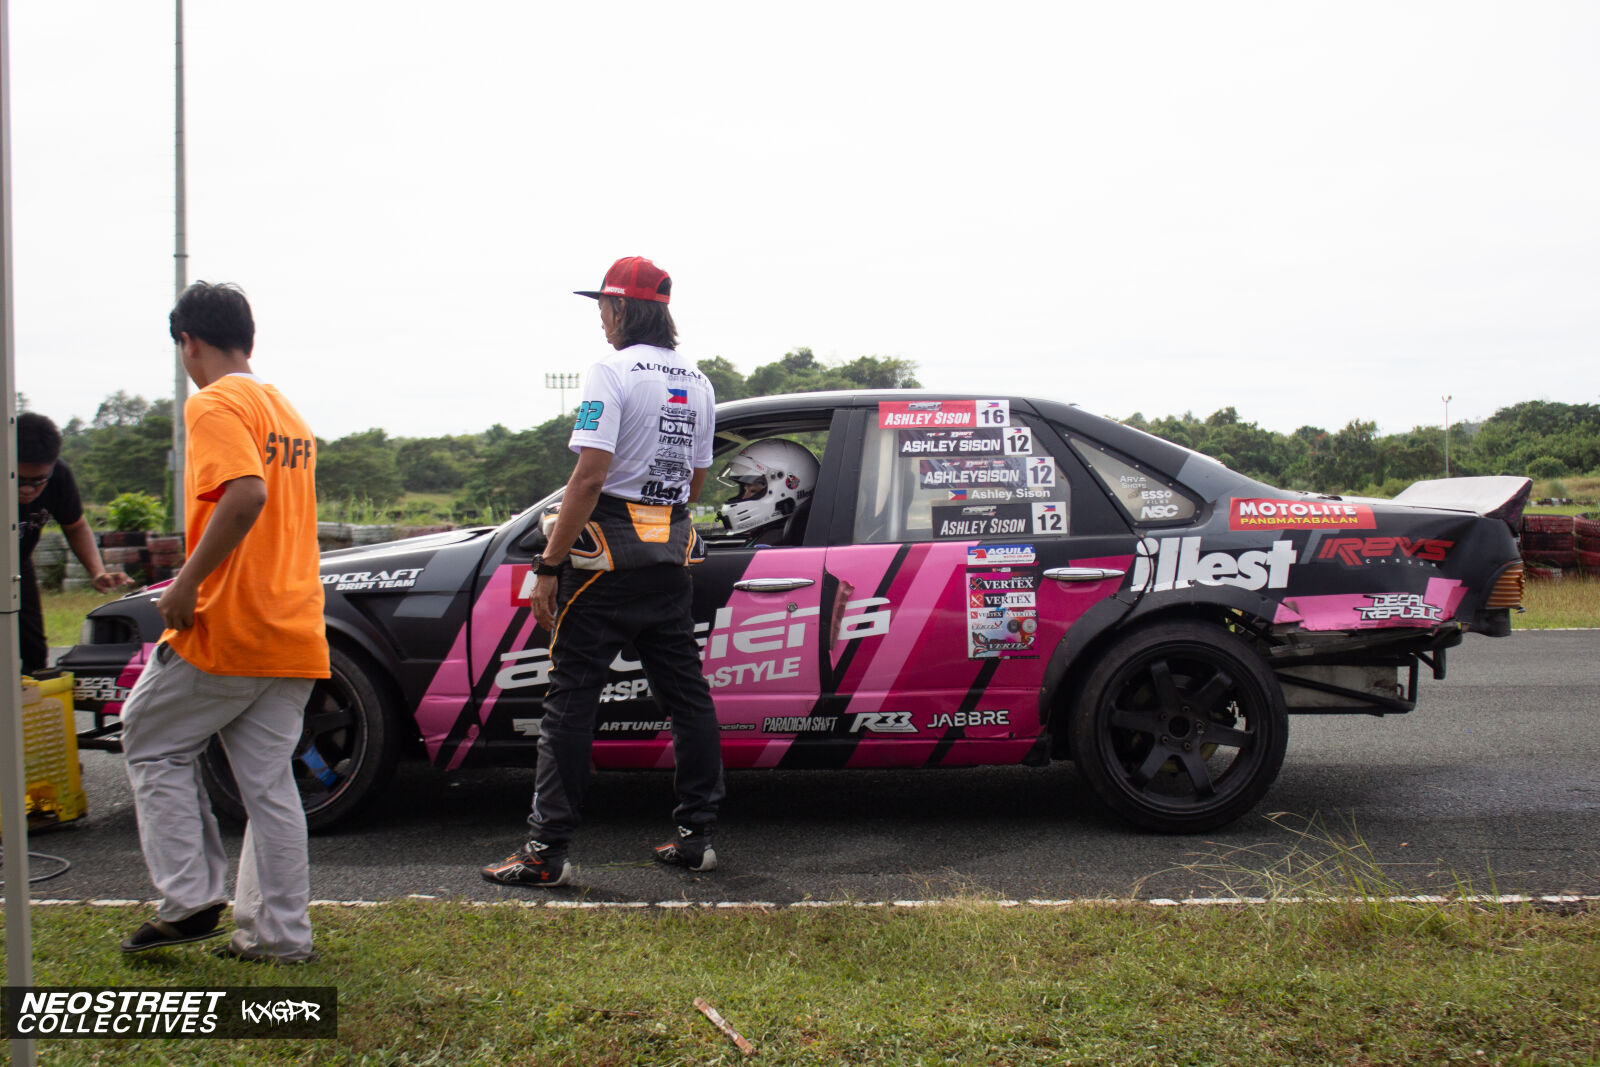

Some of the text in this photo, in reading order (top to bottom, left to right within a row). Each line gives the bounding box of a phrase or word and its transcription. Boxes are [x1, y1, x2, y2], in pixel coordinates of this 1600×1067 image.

[884, 411, 971, 426] ASHLEY SISON
[981, 409, 1004, 424] 16
[902, 439, 1001, 453] ASHLEY SISON
[1007, 434, 1030, 453] 12
[924, 469, 1020, 484] ASHLEYSISON
[1029, 465, 1053, 485] 12
[971, 488, 1051, 500] Ashley Sison
[1140, 504, 1179, 520] NSC
[1239, 501, 1357, 517] MOTOLITE
[940, 518, 1026, 535] ASHLEY SISON
[1037, 513, 1063, 531] 12
[1240, 517, 1359, 526] PANGMATAGALAN
[1130, 536, 1298, 593] illest
[319, 568, 424, 584] OCRAFT
[336, 579, 416, 591] DRIFT TEAM
[983, 579, 1034, 589] VERTEX
[985, 595, 1031, 605] VERTEX
[1366, 594, 1437, 608] DECAL
[762, 717, 811, 732] PARADIGM
[927, 710, 1009, 727] JABBRE
